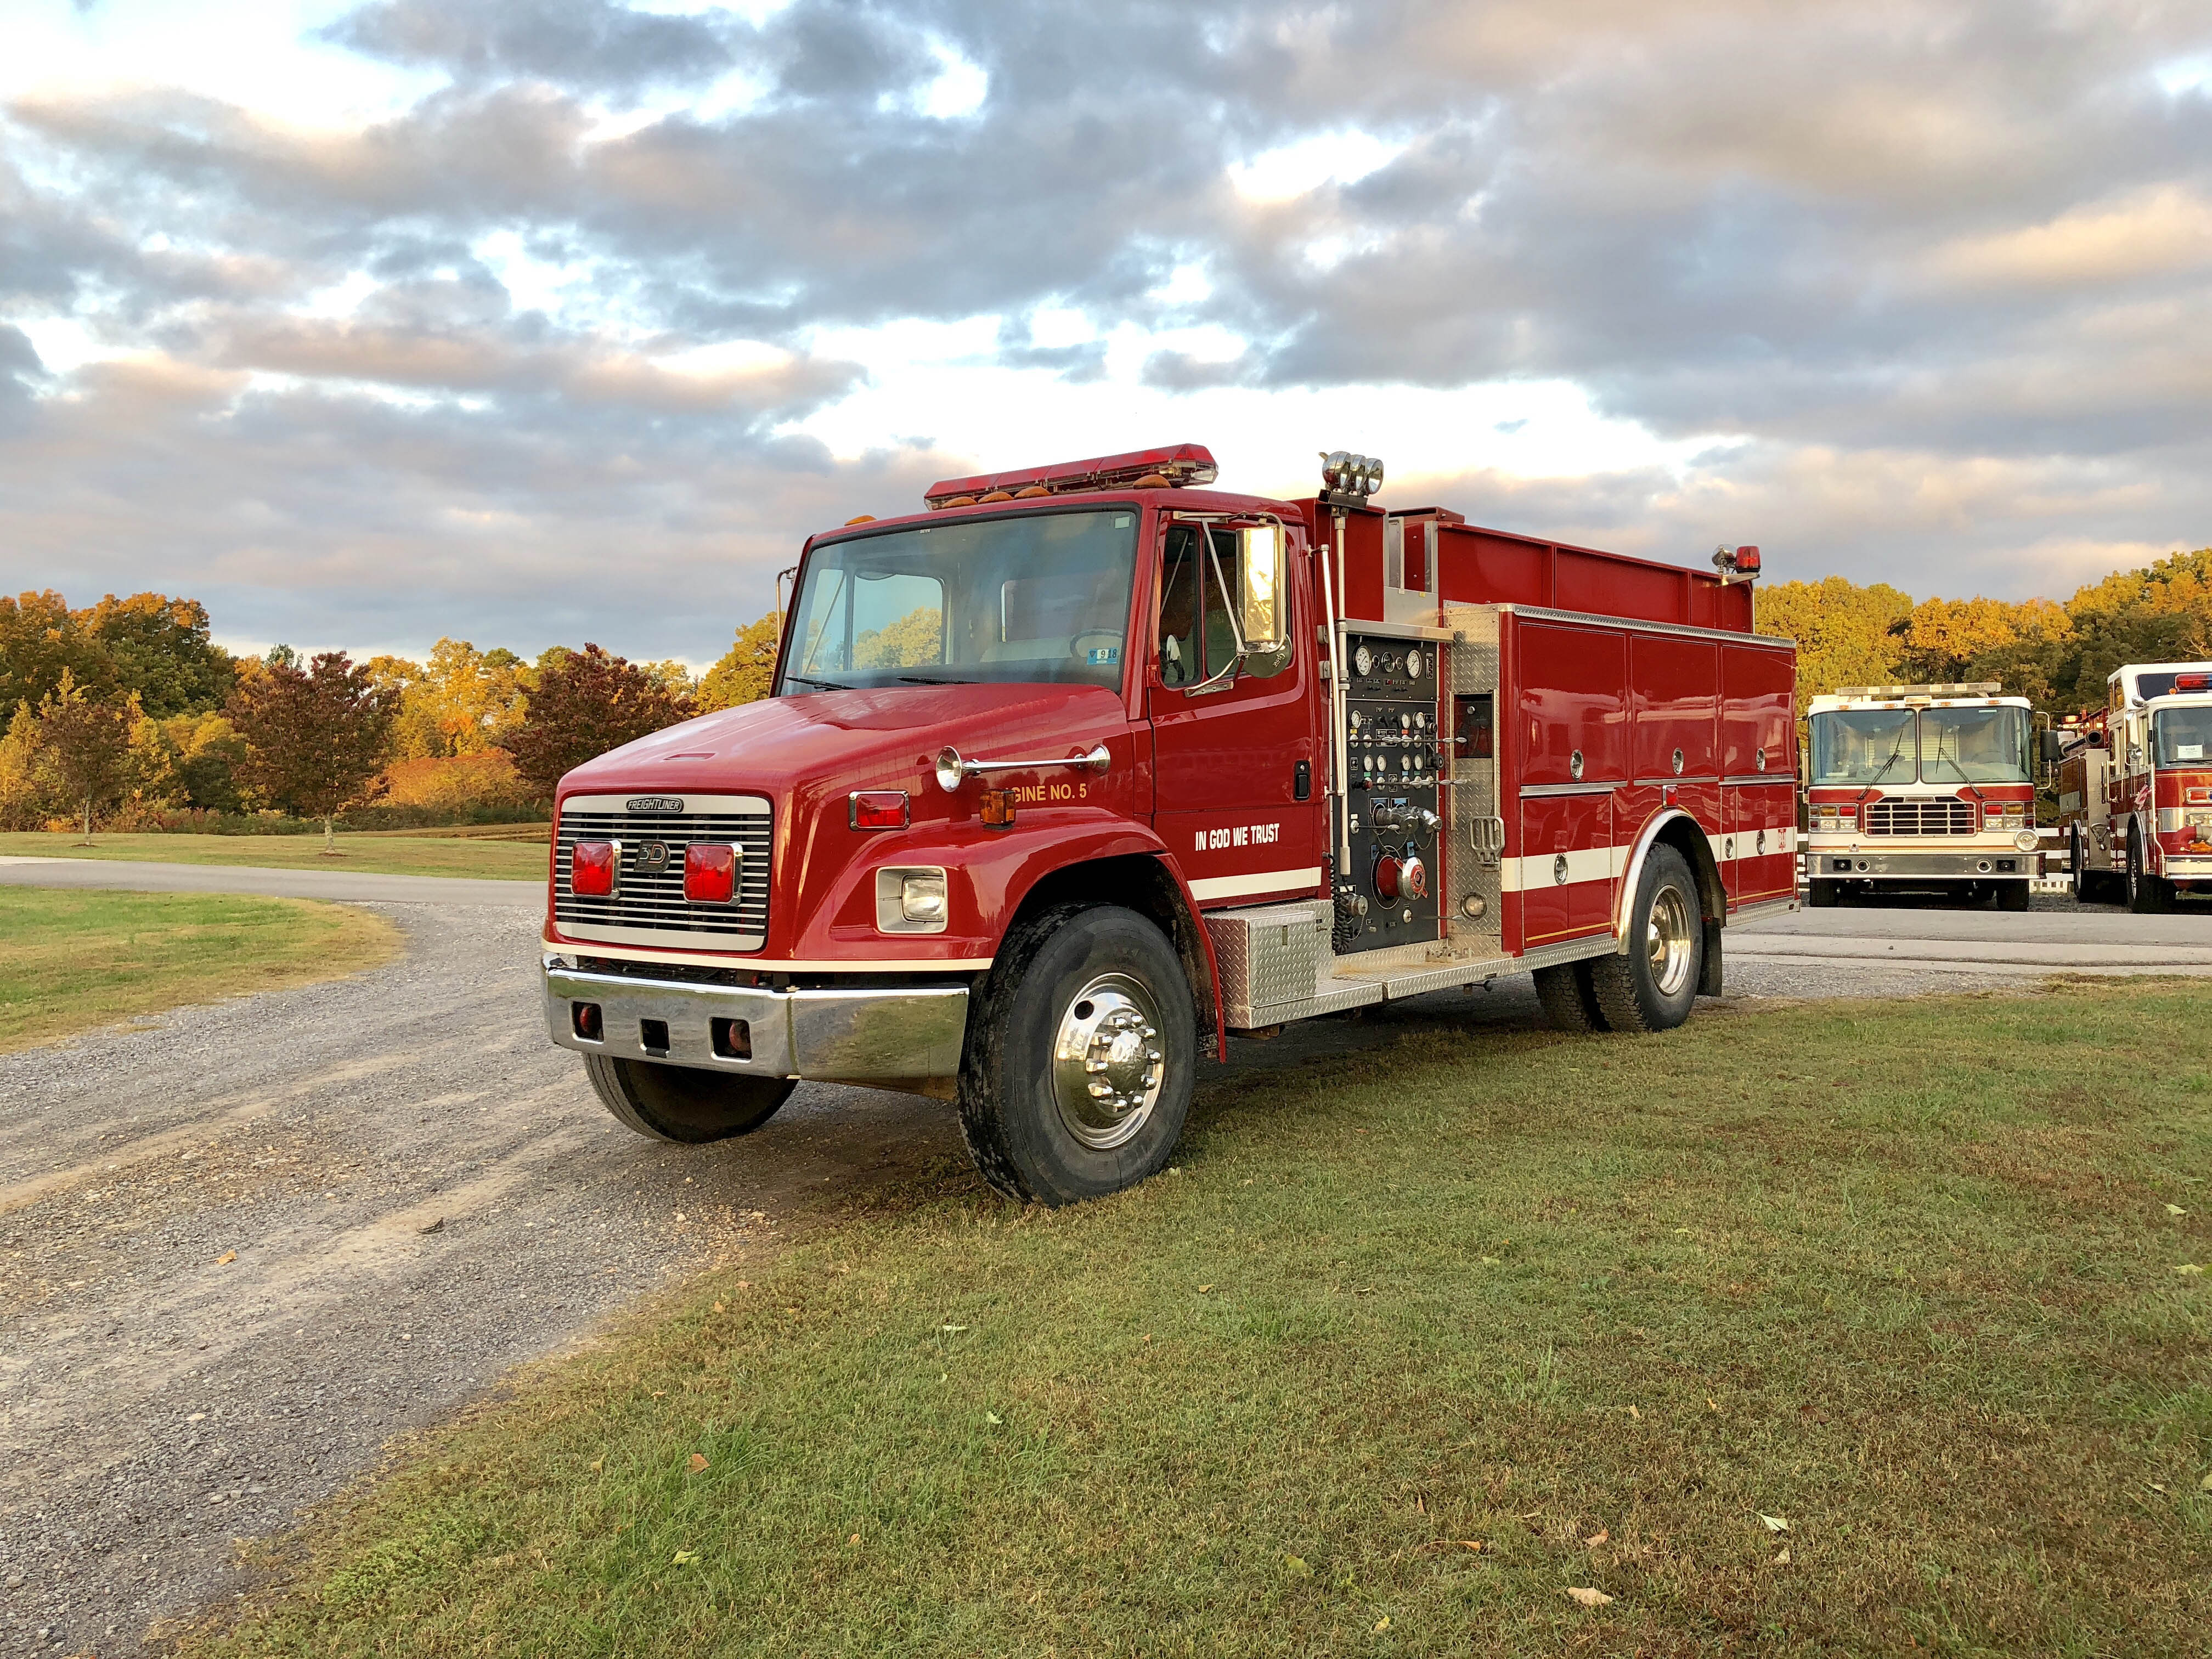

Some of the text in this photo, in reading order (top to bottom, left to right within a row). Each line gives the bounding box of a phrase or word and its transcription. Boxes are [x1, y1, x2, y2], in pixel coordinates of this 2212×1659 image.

[1101, 648, 1117, 658] 9 18
[1006, 783, 1087, 803] GINE NO. 5
[627, 798, 680, 810] FREIGHTLINER
[1195, 823, 1280, 851] IN GOD WE TRUST
